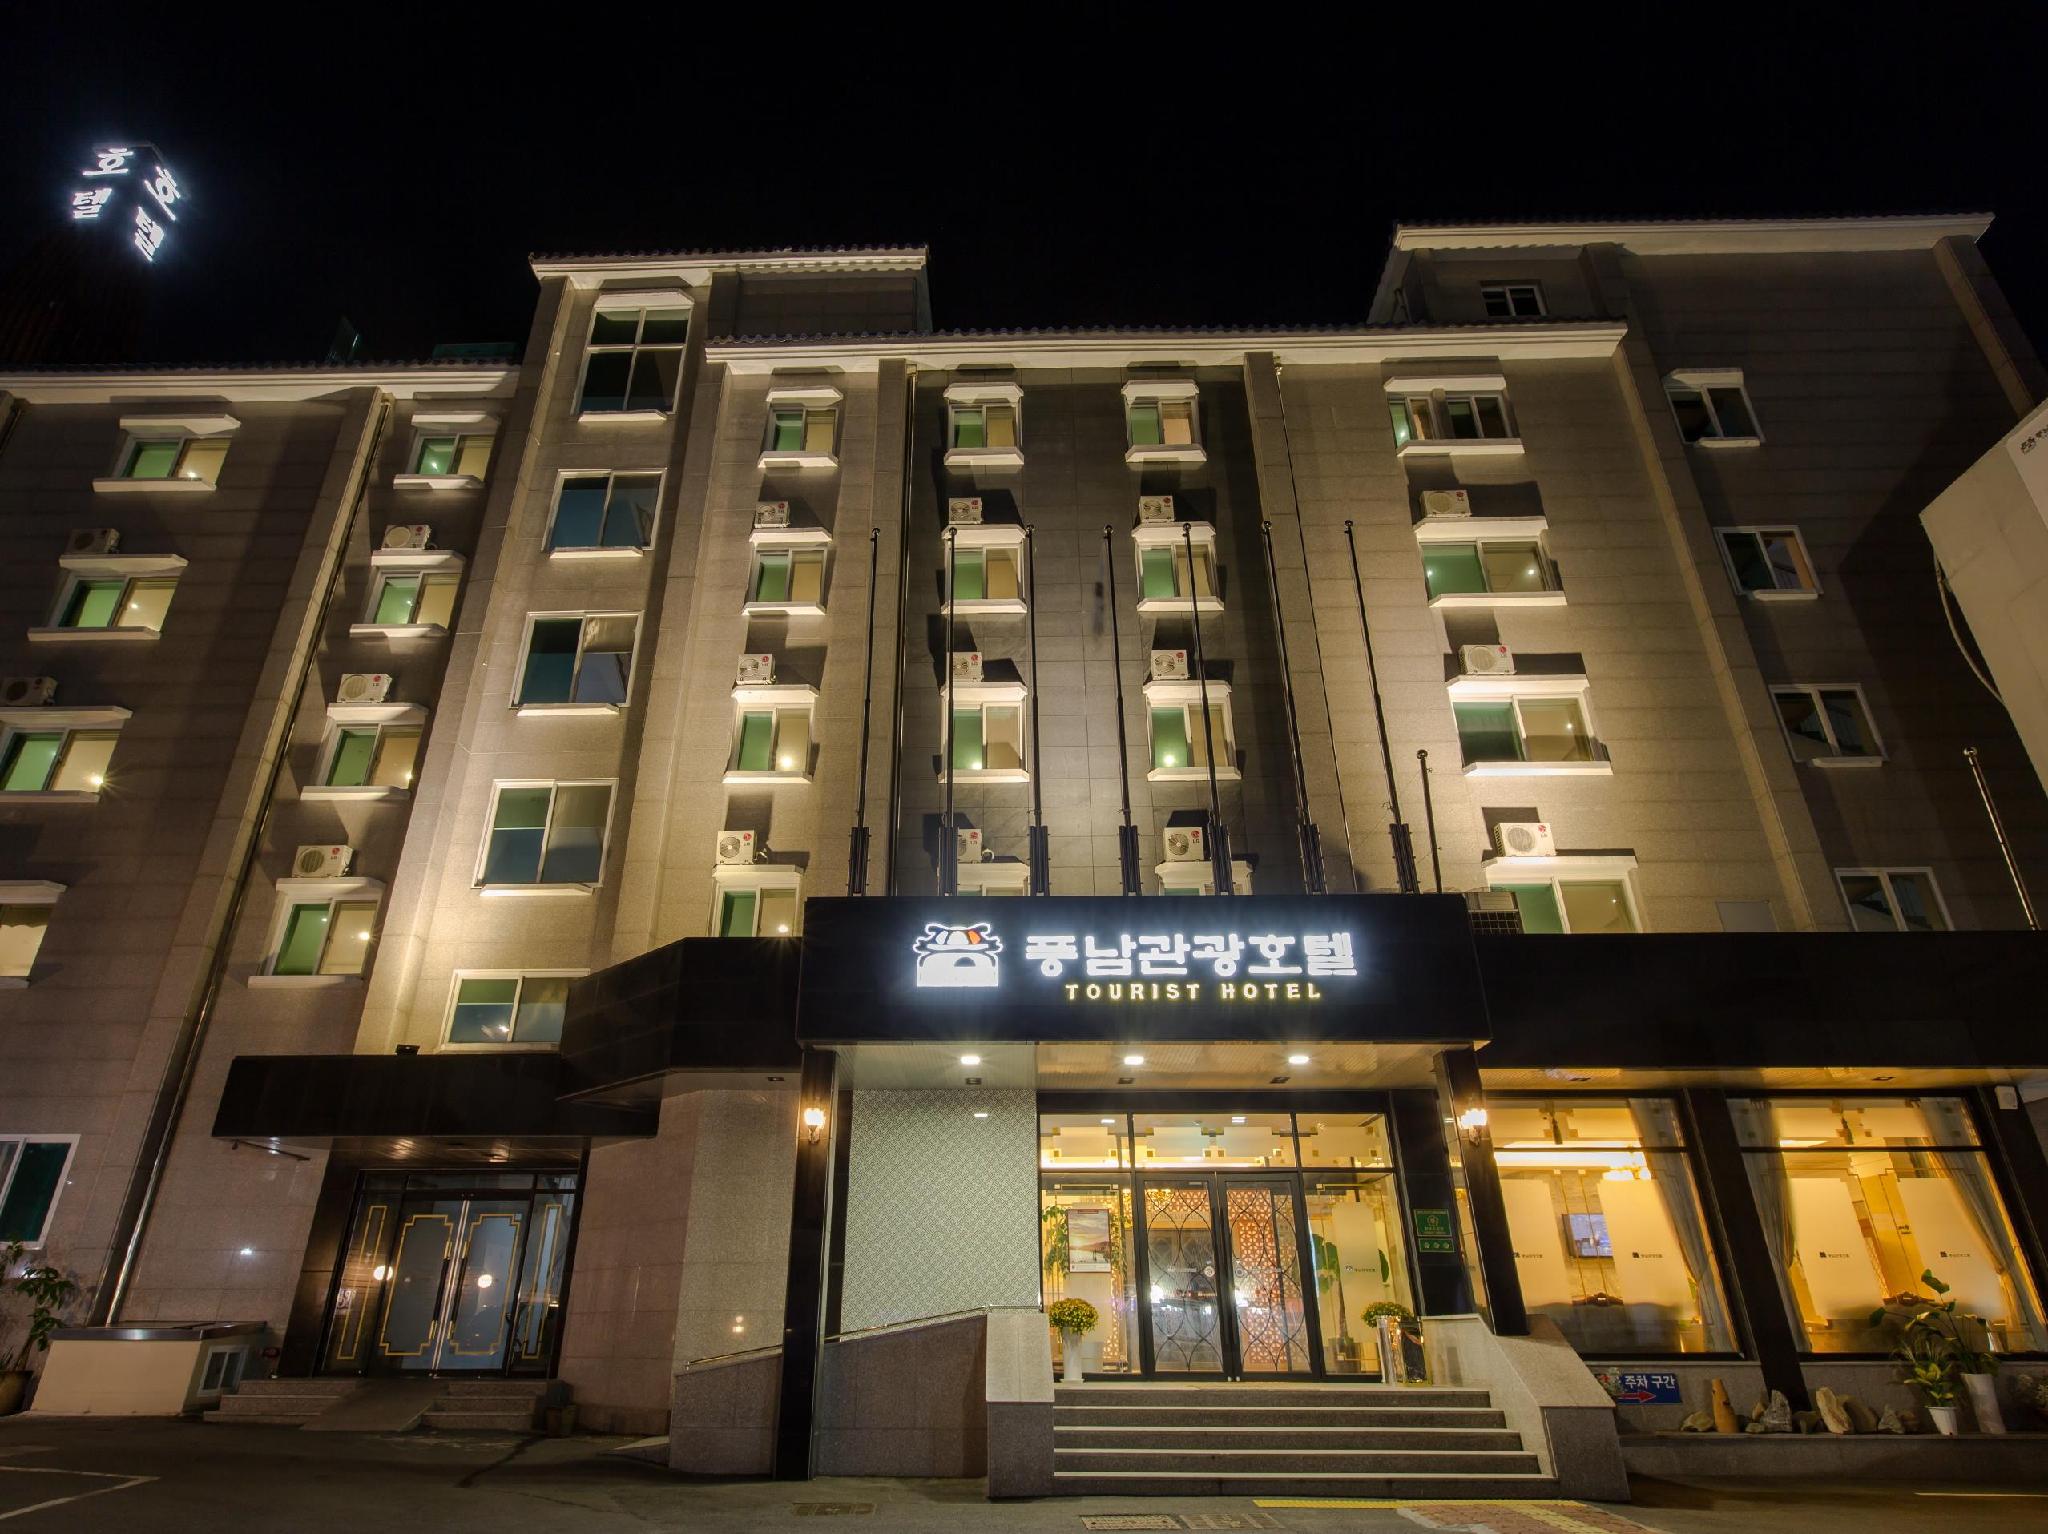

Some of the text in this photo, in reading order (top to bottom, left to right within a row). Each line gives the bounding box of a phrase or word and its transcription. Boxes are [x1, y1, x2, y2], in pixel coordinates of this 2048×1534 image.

[73, 148, 134, 219] 호텔
[135, 166, 181, 262] 호텔
[1025, 931, 1358, 978] 풍남관광호텔
[1065, 983, 1321, 1000] TOURIST HOTEL
[1624, 1374, 1676, 1389] 주차 구간
